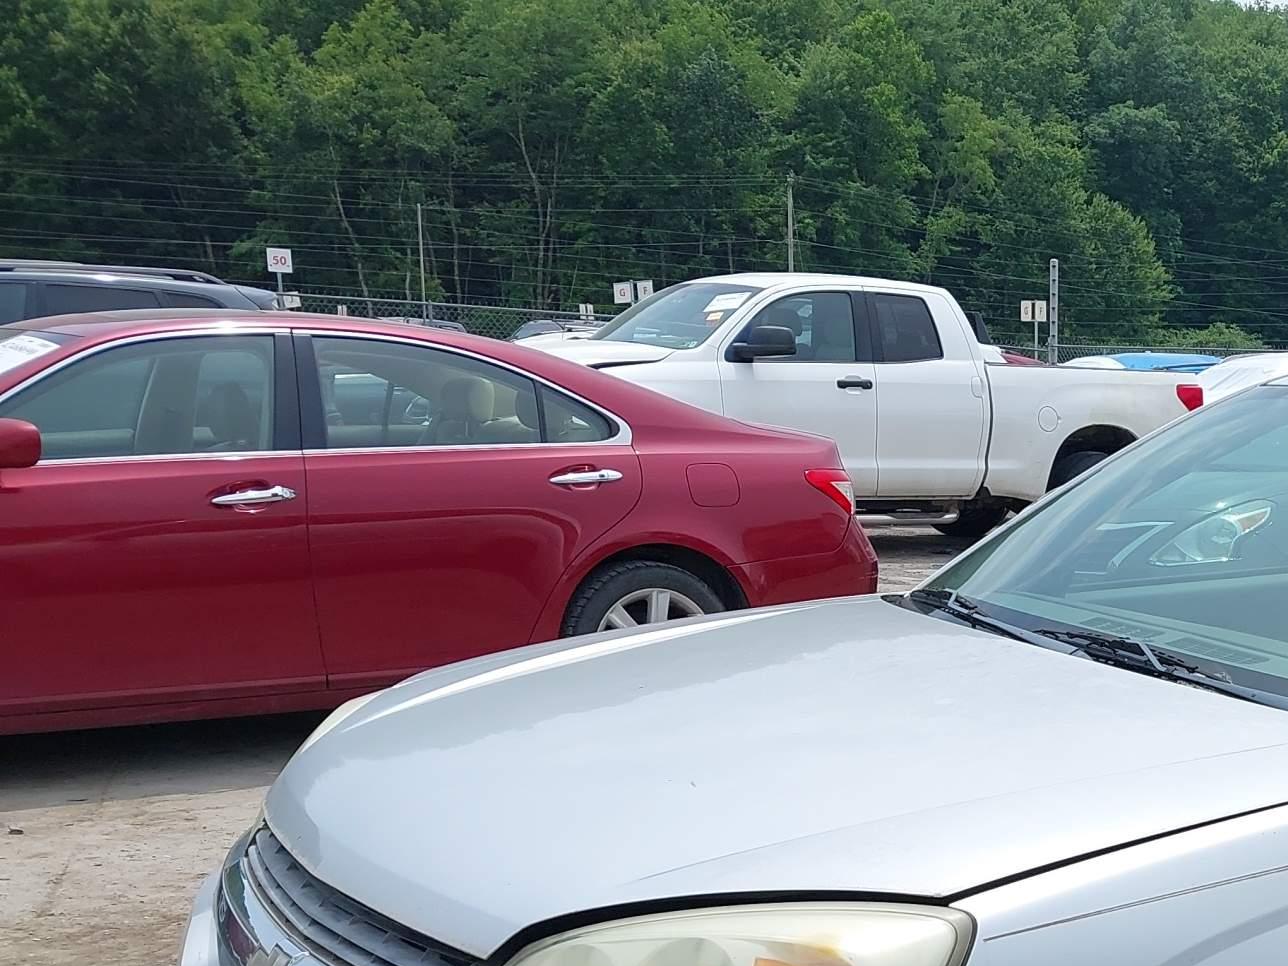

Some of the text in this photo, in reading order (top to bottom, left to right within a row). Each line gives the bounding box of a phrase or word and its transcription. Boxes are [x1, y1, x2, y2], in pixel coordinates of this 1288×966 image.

[272, 255, 287, 266] 50
[619, 288, 626, 297] G
[642, 286, 648, 295] F
